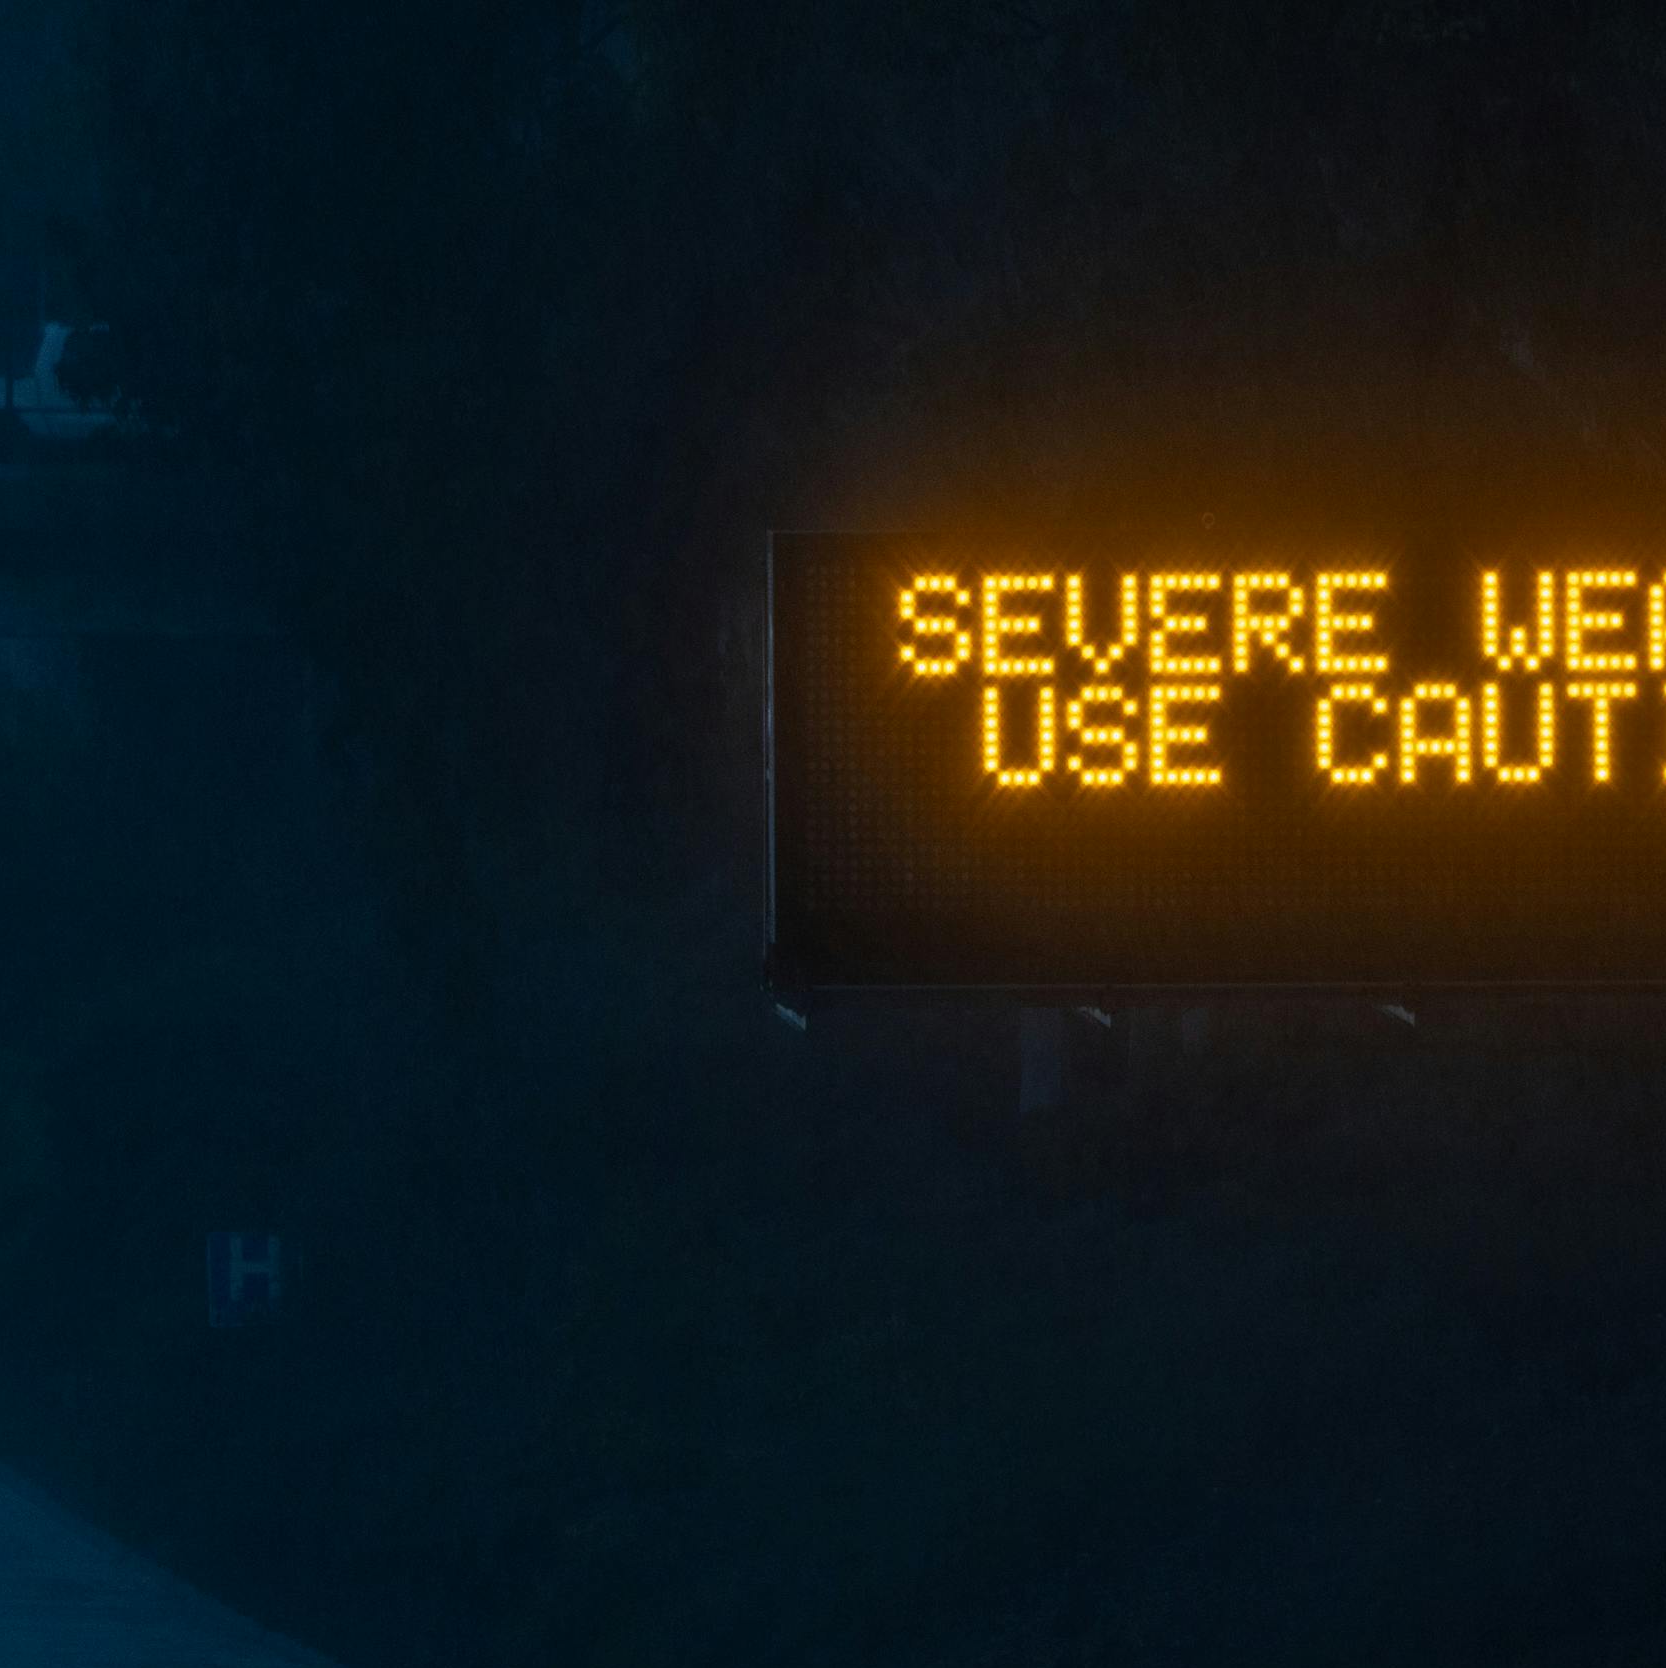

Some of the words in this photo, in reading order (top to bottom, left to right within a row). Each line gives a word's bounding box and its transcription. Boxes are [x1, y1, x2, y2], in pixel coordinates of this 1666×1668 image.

[895, 568, 1391, 679] SEVERE
[979, 679, 1223, 789] USE
[228, 1234, 282, 1302] H
